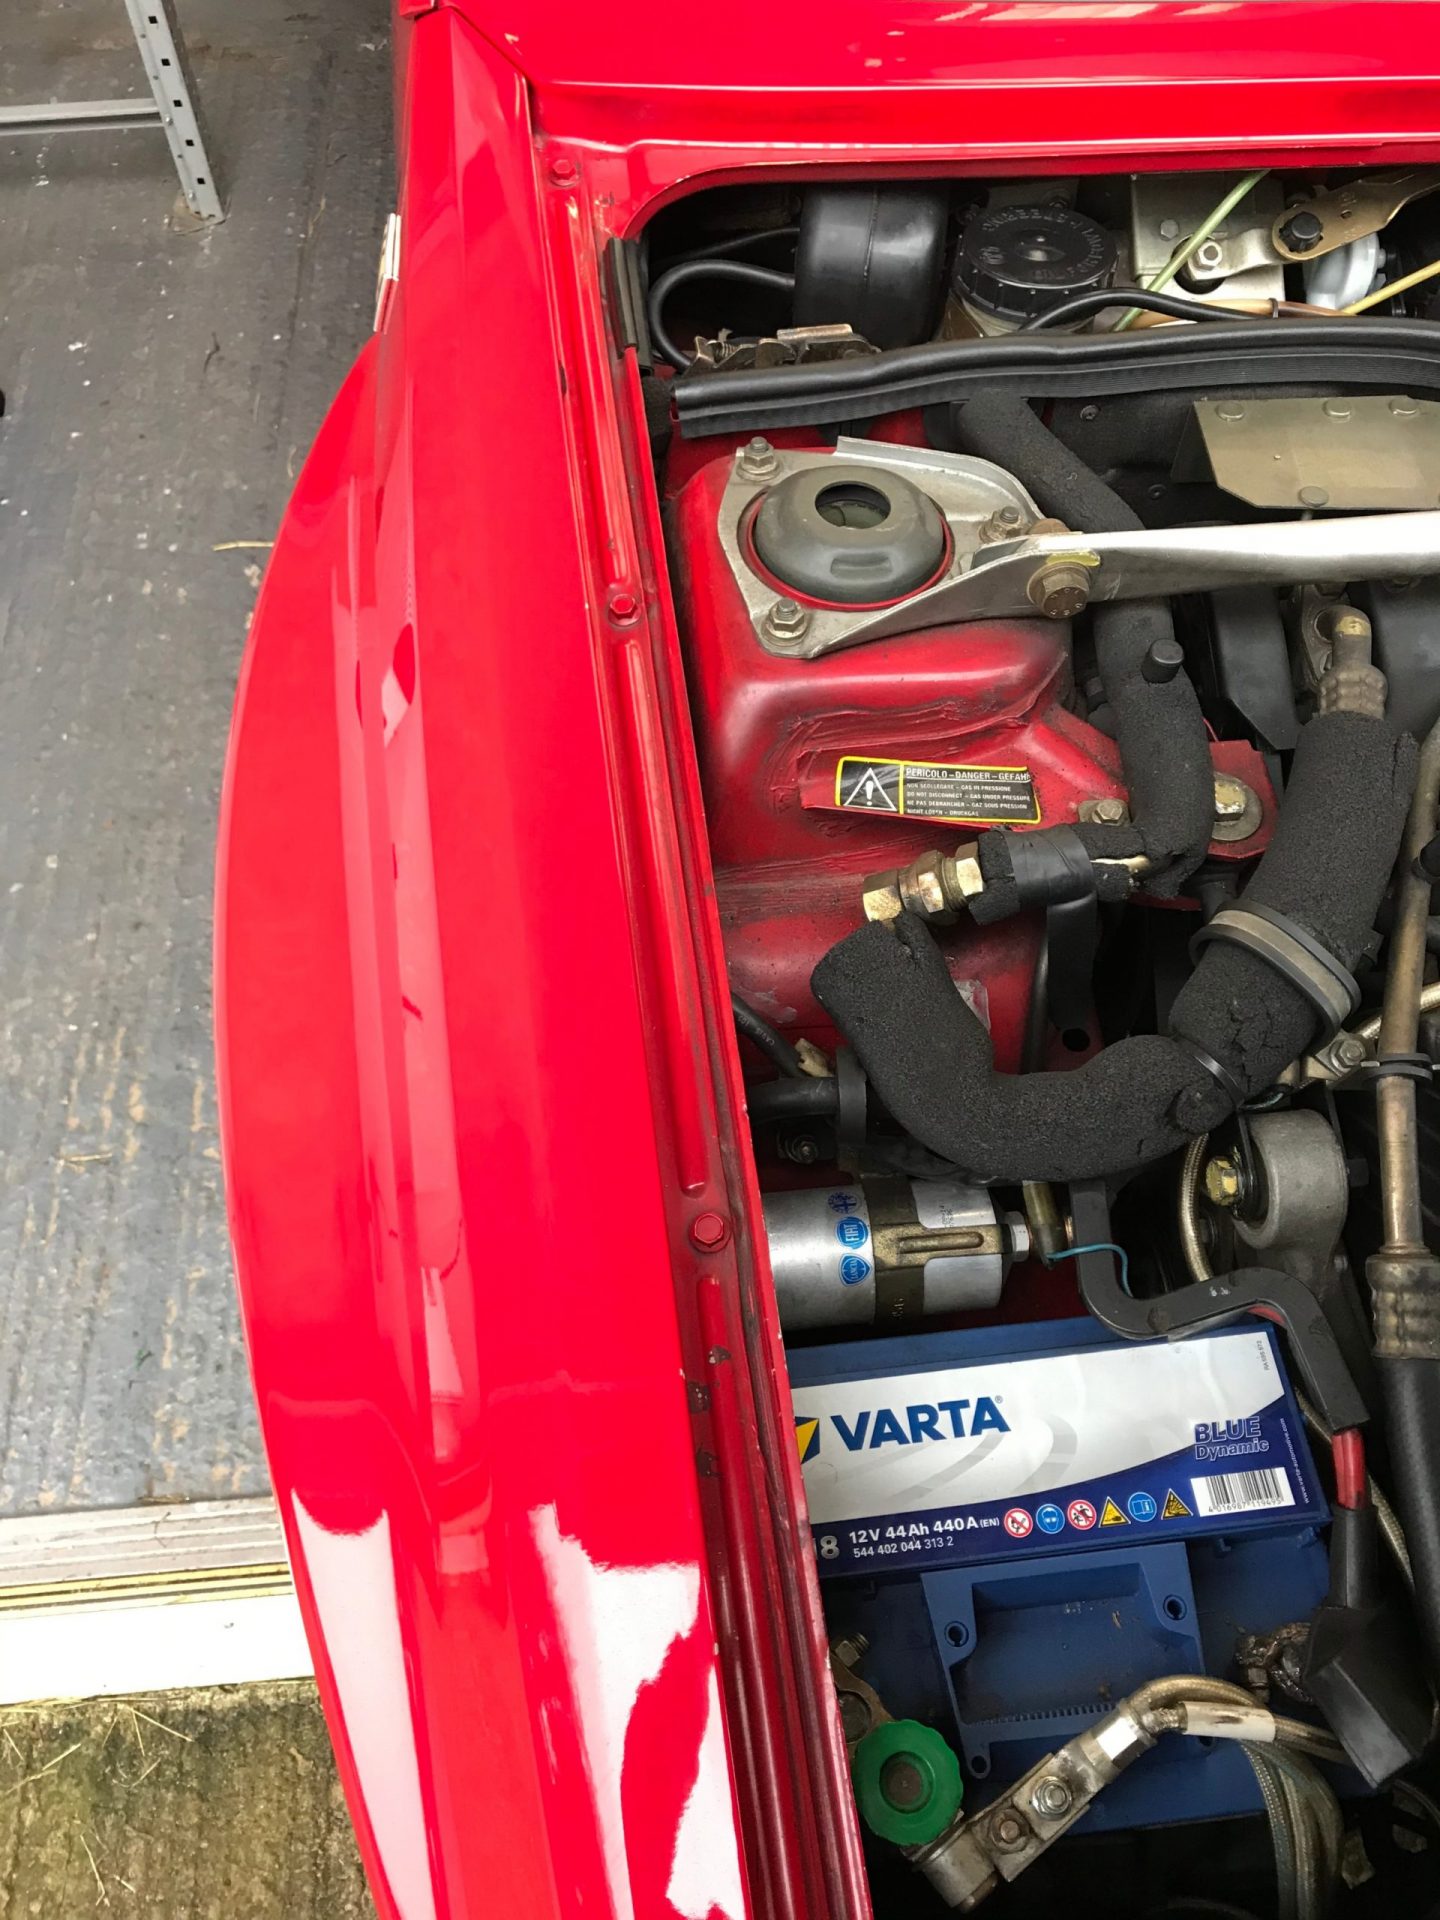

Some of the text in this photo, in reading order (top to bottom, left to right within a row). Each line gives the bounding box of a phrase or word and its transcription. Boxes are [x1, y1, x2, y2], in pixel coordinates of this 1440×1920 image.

[906, 767, 948, 778] PERICOLO
[955, 771, 991, 779] DANGER
[844, 1224, 860, 1242] FIAT
[849, 1259, 859, 1280] LANCIA
[1194, 1416, 1262, 1444] BLUE
[1195, 1438, 1270, 1461] Dynamic
[1279, 1417, 1310, 1504] www.varta-automotive.com
[849, 1528, 880, 1543] 12V
[885, 1523, 930, 1539] 44Ah
[853, 1535, 954, 1558] 544 402 044 313 2
